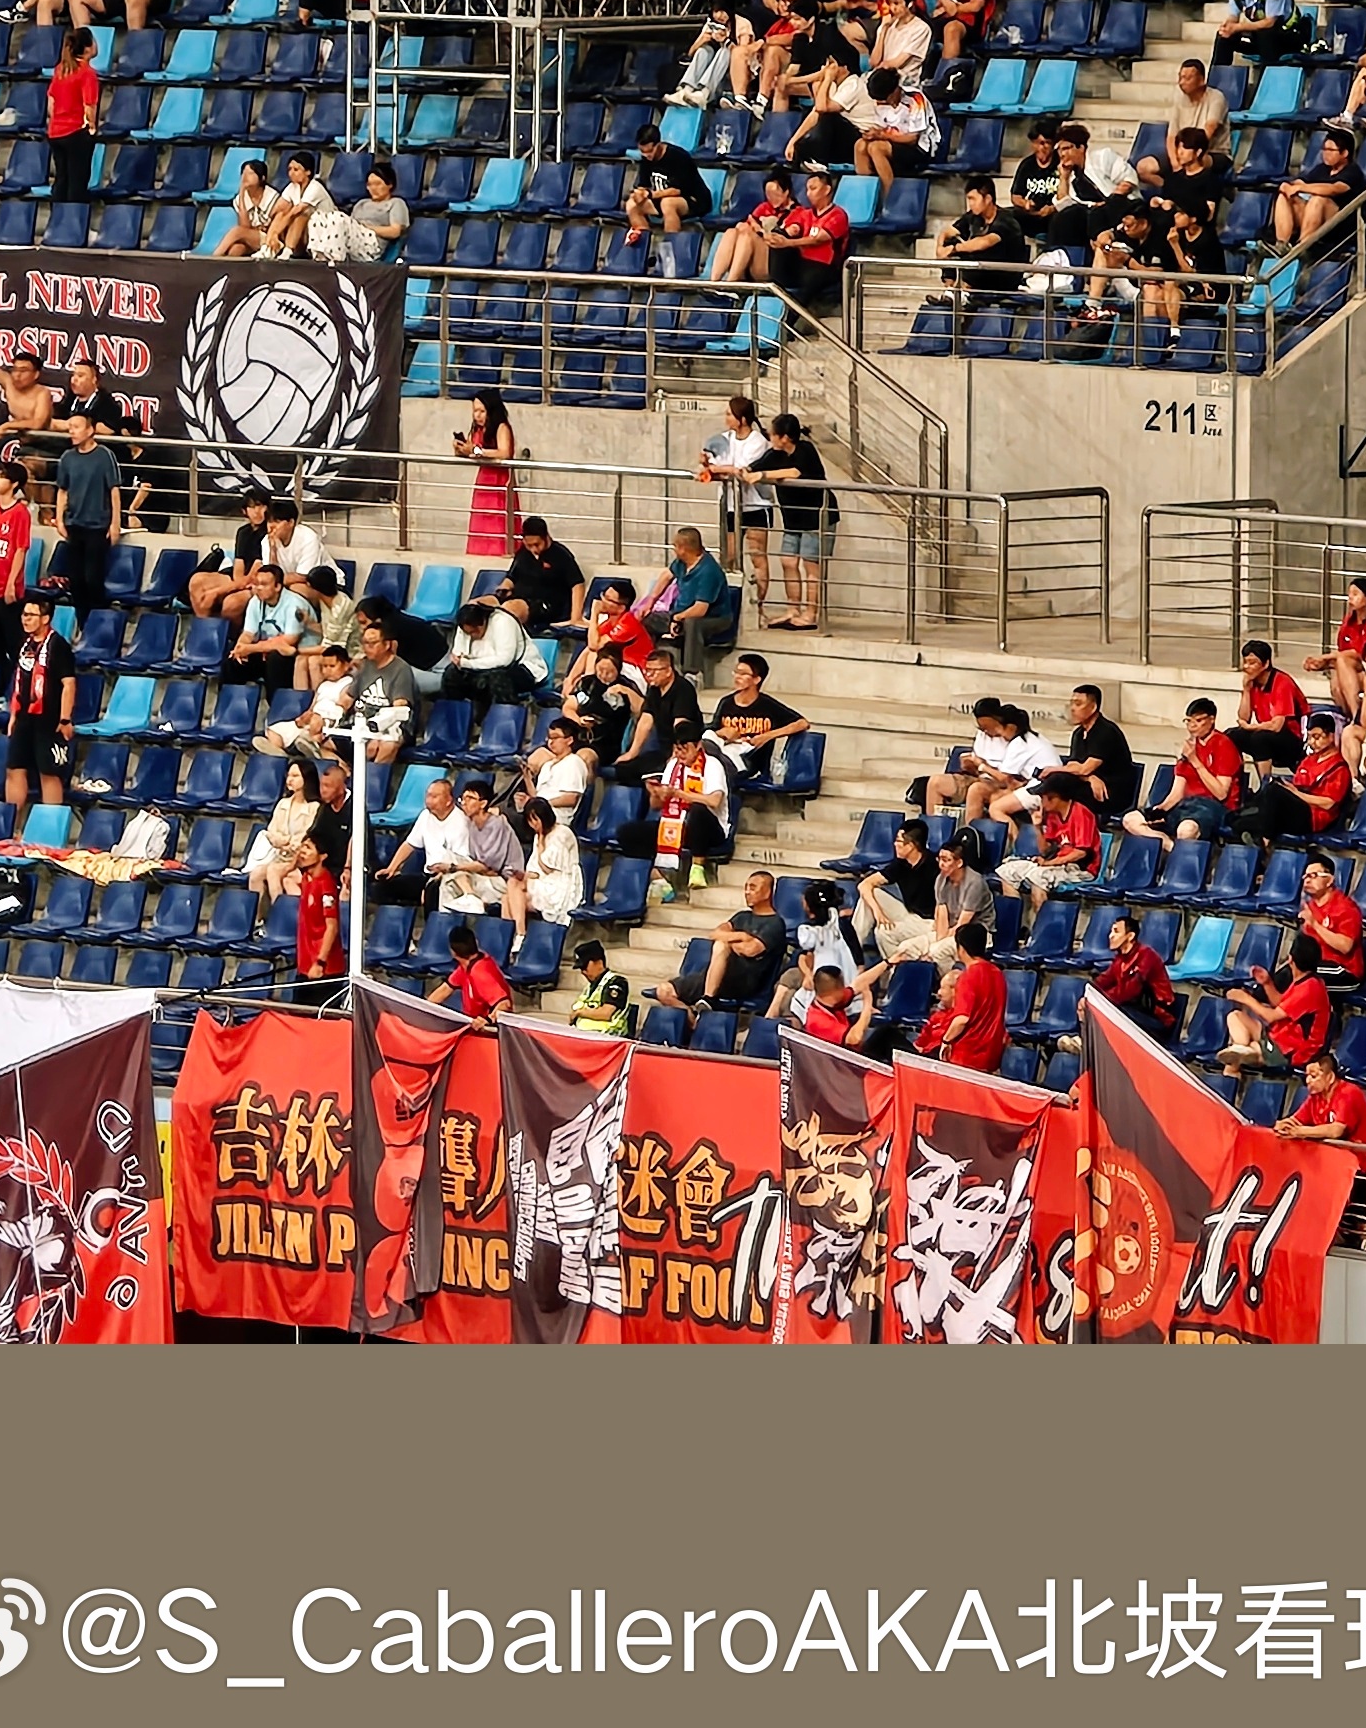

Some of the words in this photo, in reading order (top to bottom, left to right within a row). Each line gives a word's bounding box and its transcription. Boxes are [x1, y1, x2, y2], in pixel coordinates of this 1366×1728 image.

[26, 271, 165, 324] NEVER
[1143, 399, 1196, 436] 211
[216, 1202, 314, 1265] JILIN
